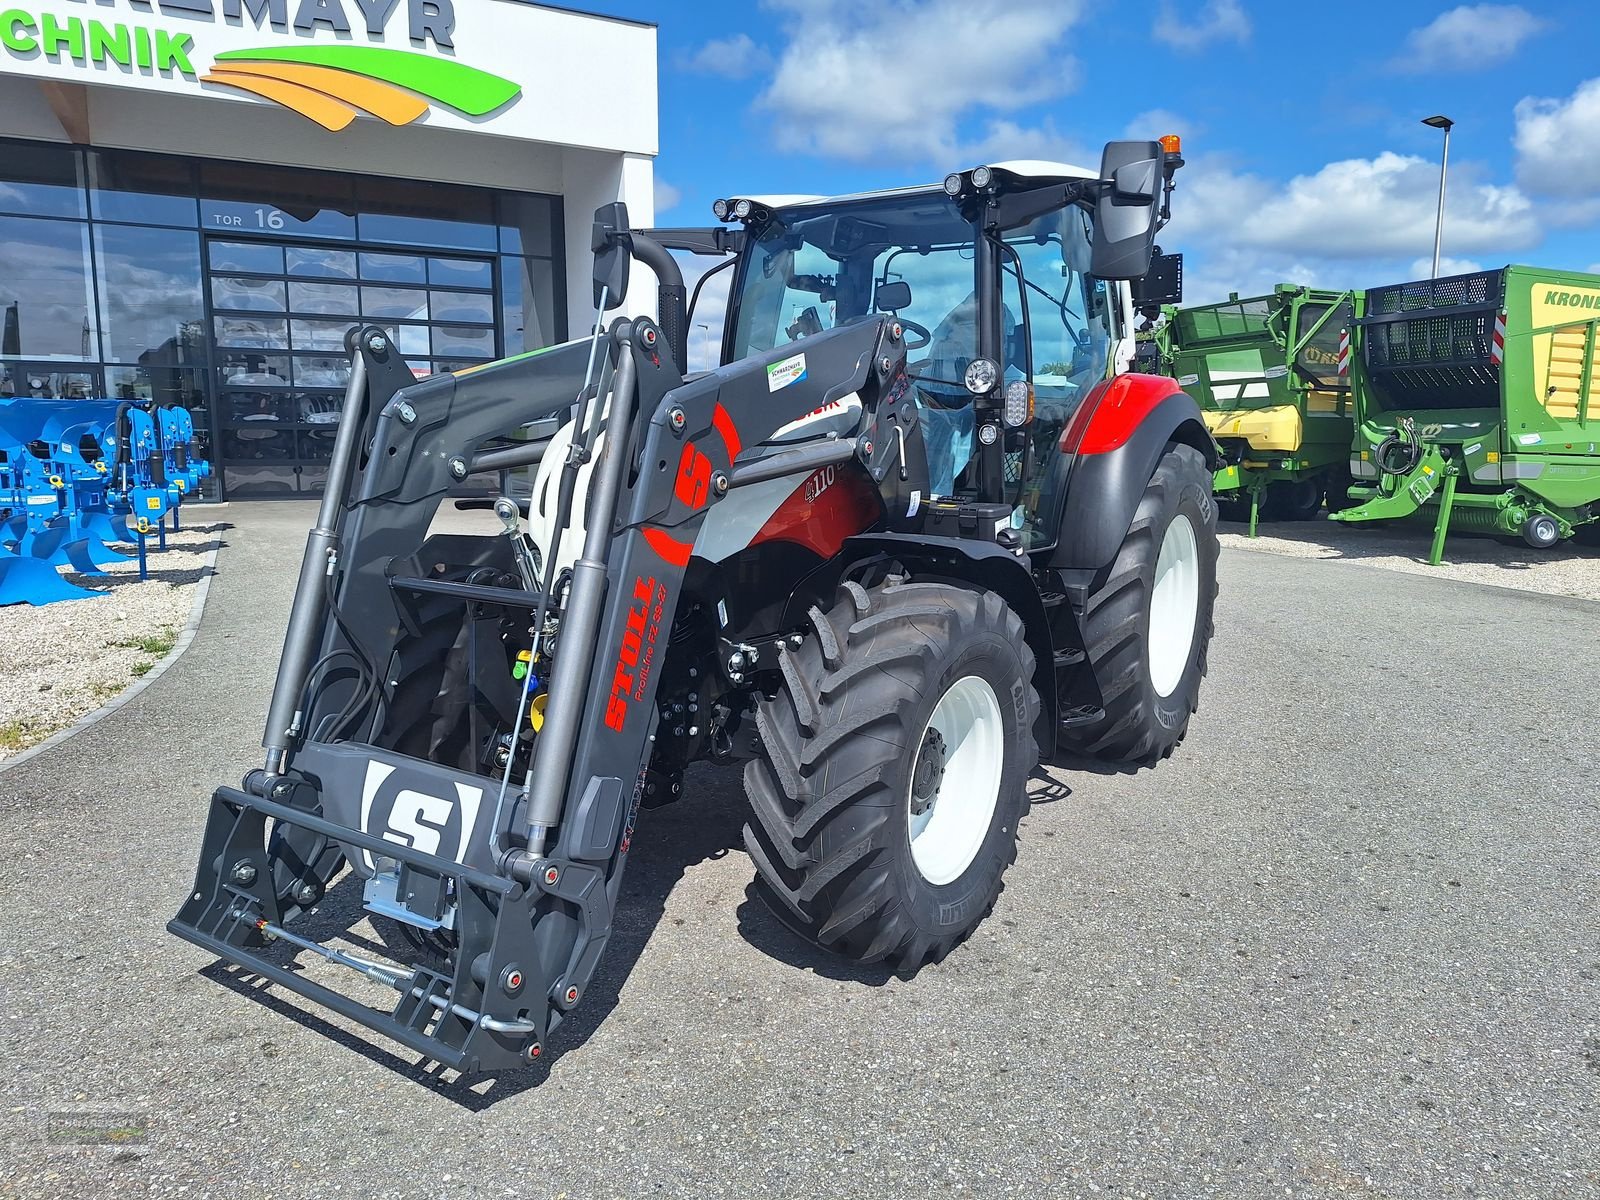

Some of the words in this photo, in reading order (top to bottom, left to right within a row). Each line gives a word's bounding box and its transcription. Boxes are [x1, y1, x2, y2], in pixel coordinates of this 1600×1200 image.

[0, 9, 195, 74] CHNIK
[213, 214, 242, 226] TOR
[254, 208, 284, 229] 16
[1544, 290, 1600, 309] KRONE
[804, 464, 835, 503] 4110
[604, 575, 656, 733] STOLL
[634, 643, 654, 702] ProfiLine
[648, 623, 659, 643] FZ
